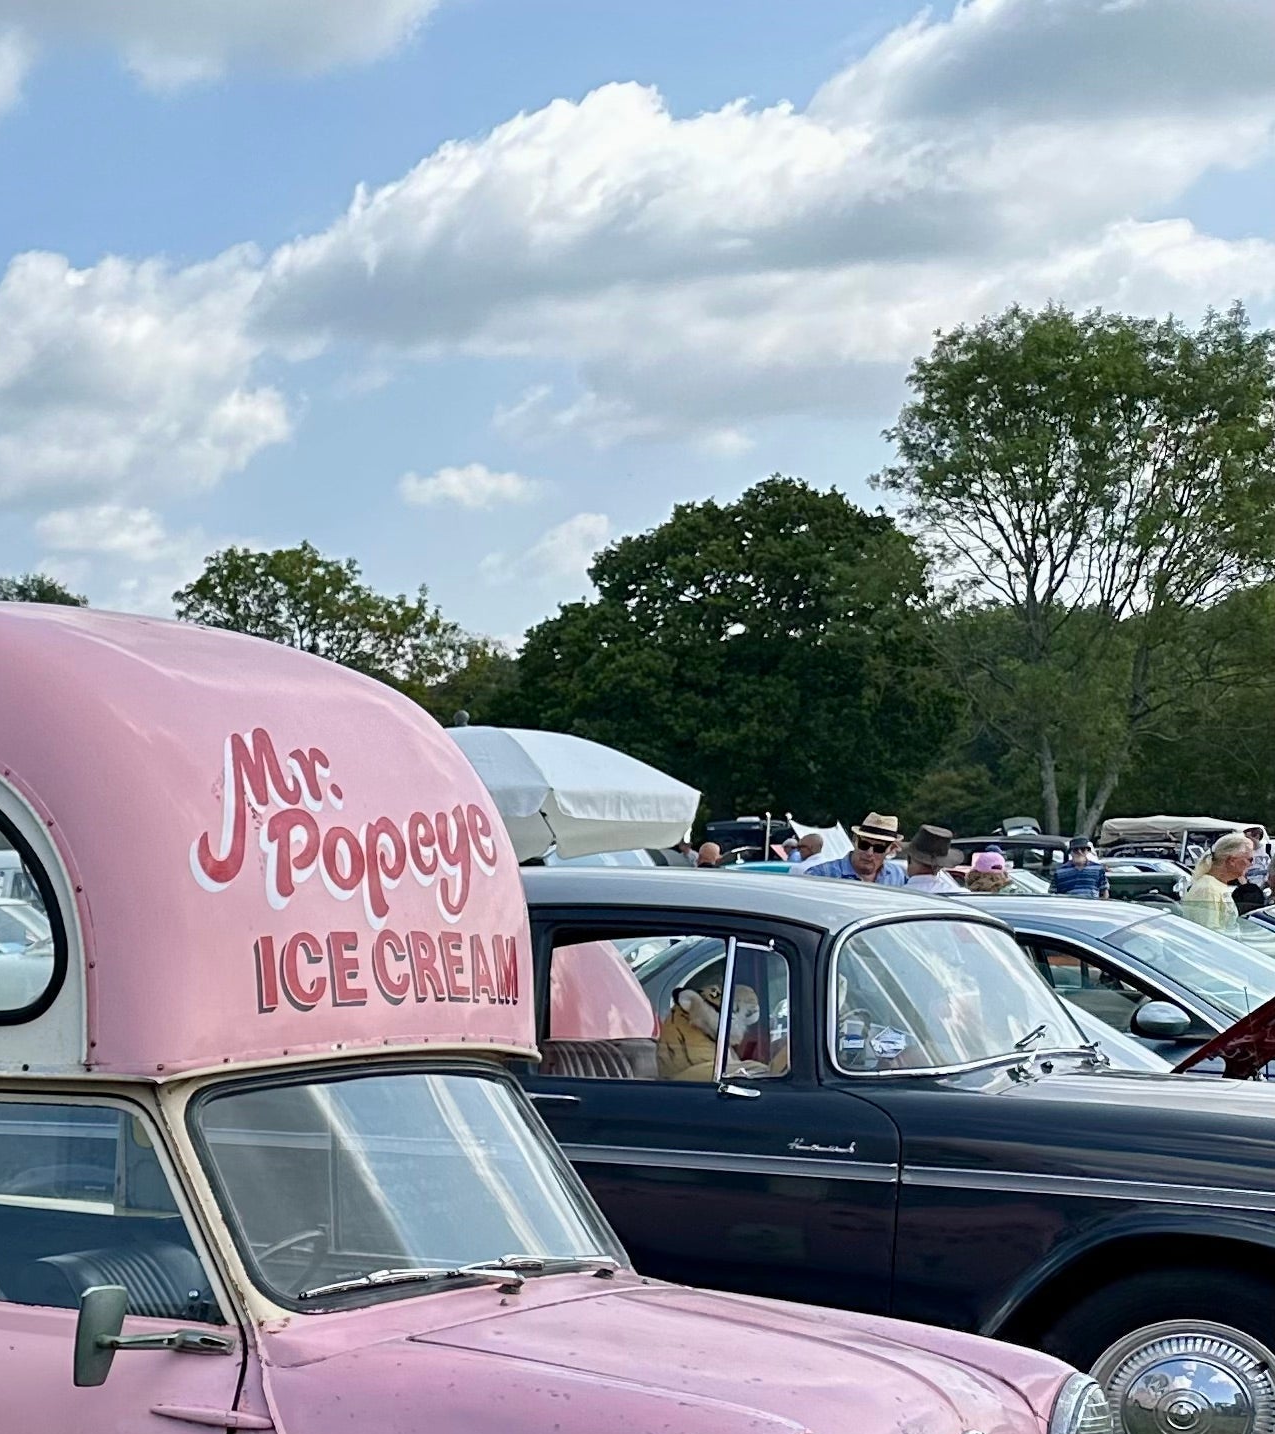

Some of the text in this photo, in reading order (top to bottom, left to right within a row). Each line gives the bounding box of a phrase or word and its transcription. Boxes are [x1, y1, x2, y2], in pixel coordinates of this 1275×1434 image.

[190, 727, 344, 892] Mr.
[260, 803, 497, 929] Popeye
[254, 929, 519, 1014] ICE CREAM
